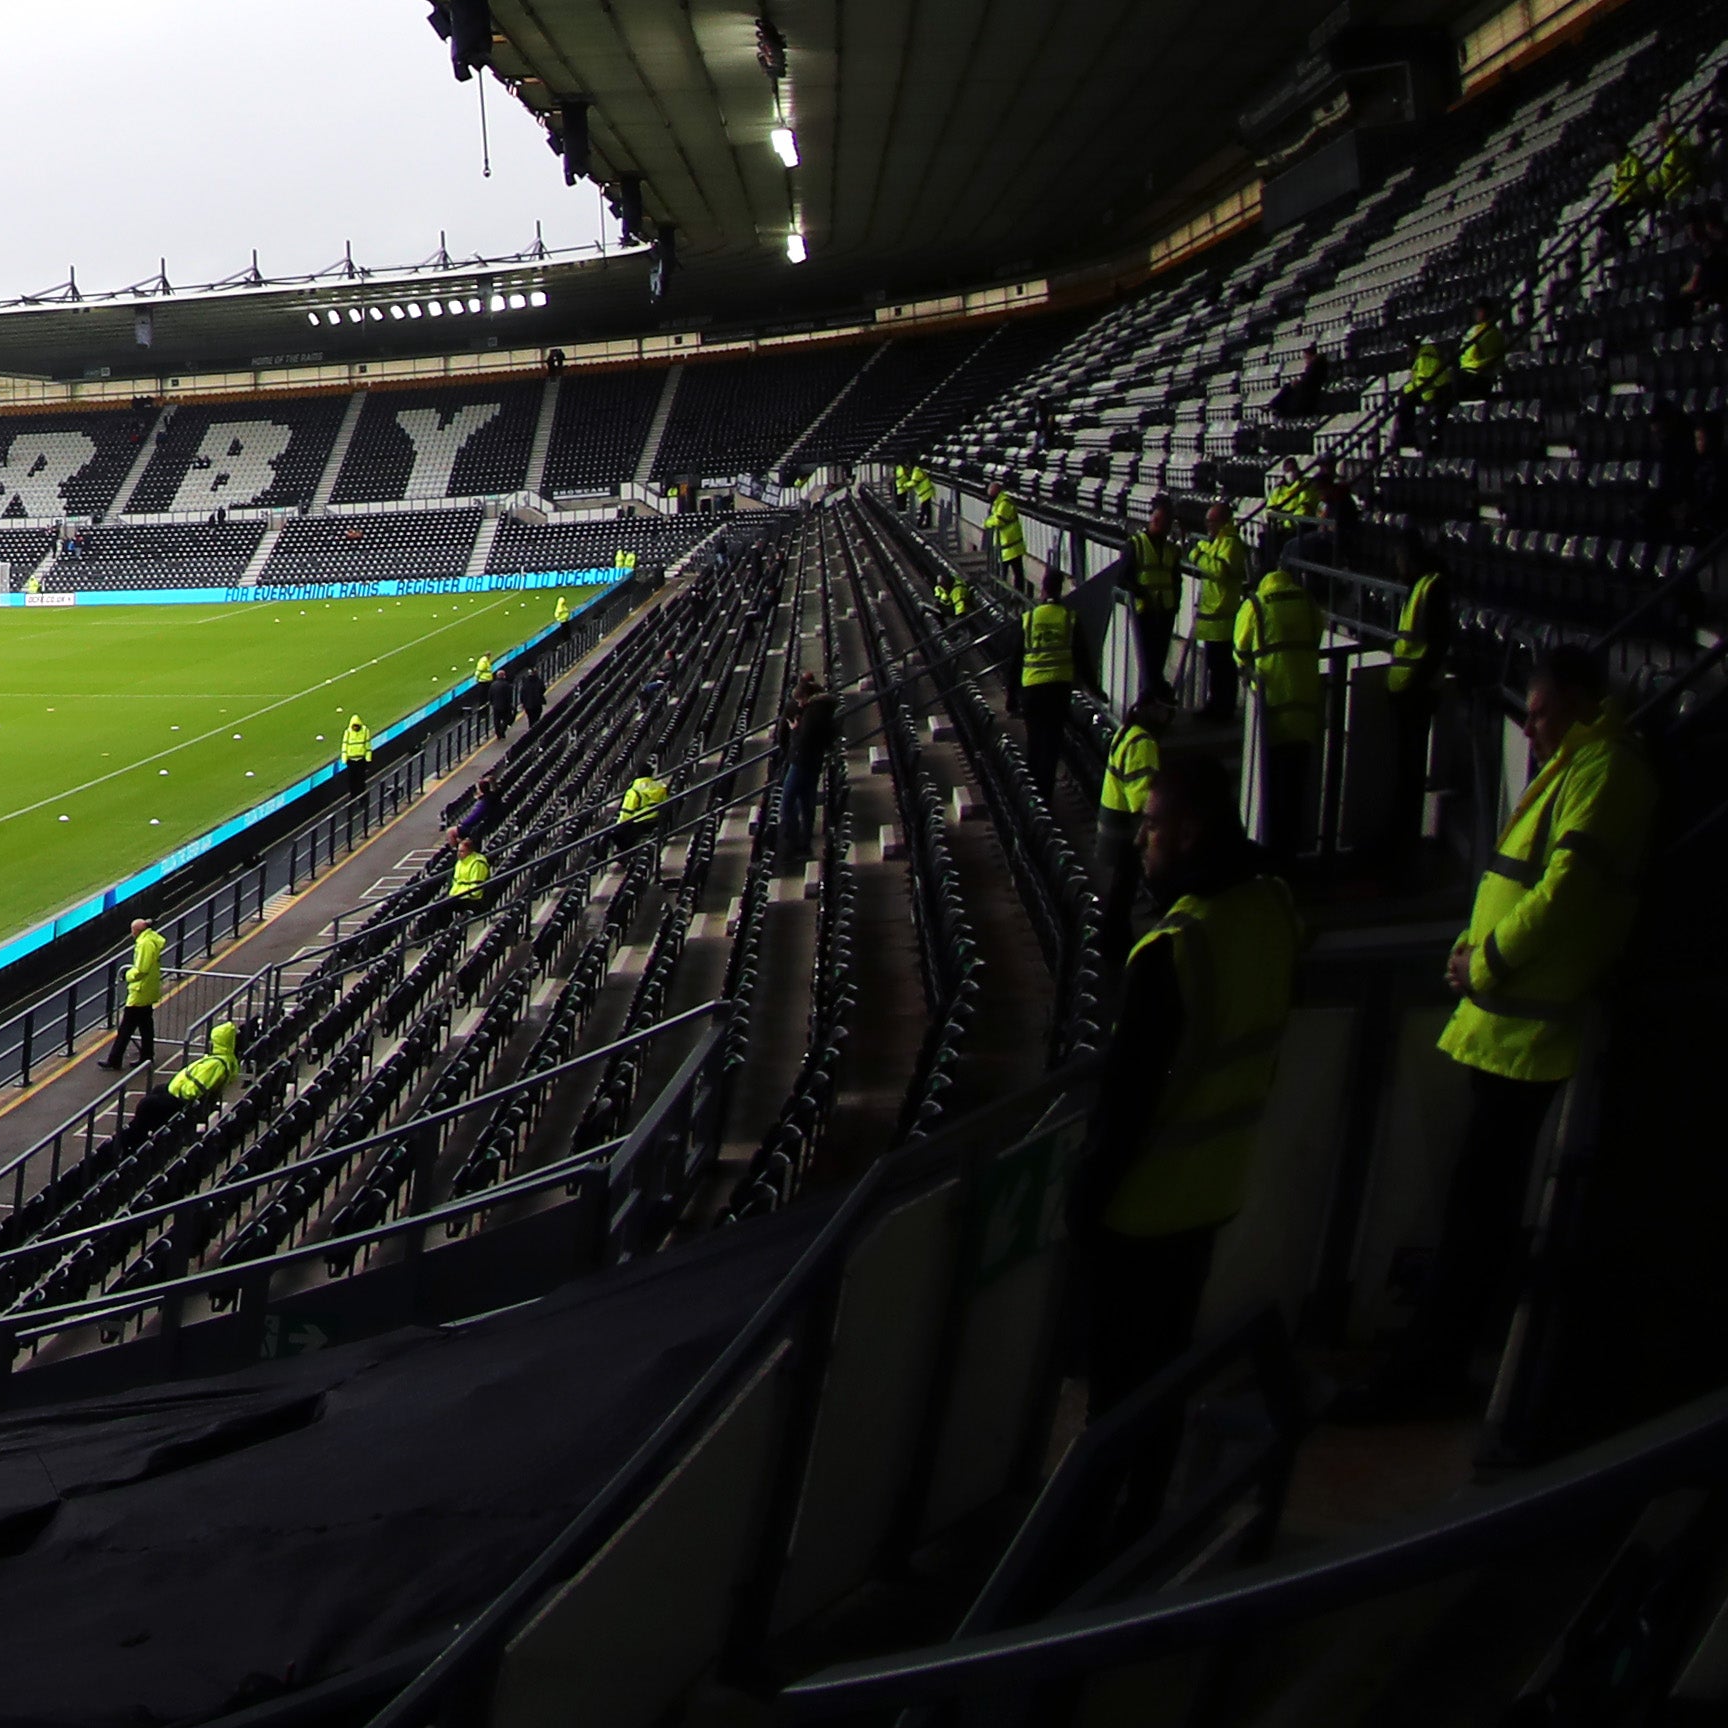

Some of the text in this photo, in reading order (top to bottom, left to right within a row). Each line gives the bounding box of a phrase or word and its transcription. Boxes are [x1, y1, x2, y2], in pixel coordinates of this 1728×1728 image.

[224, 587, 247, 602] FOR
[254, 583, 334, 602] EVERYTHING
[396, 578, 459, 596] REGISTER
[465, 575, 484, 592] OR
[489, 572, 524, 591] LOGIN
[534, 571, 547, 587] TO
